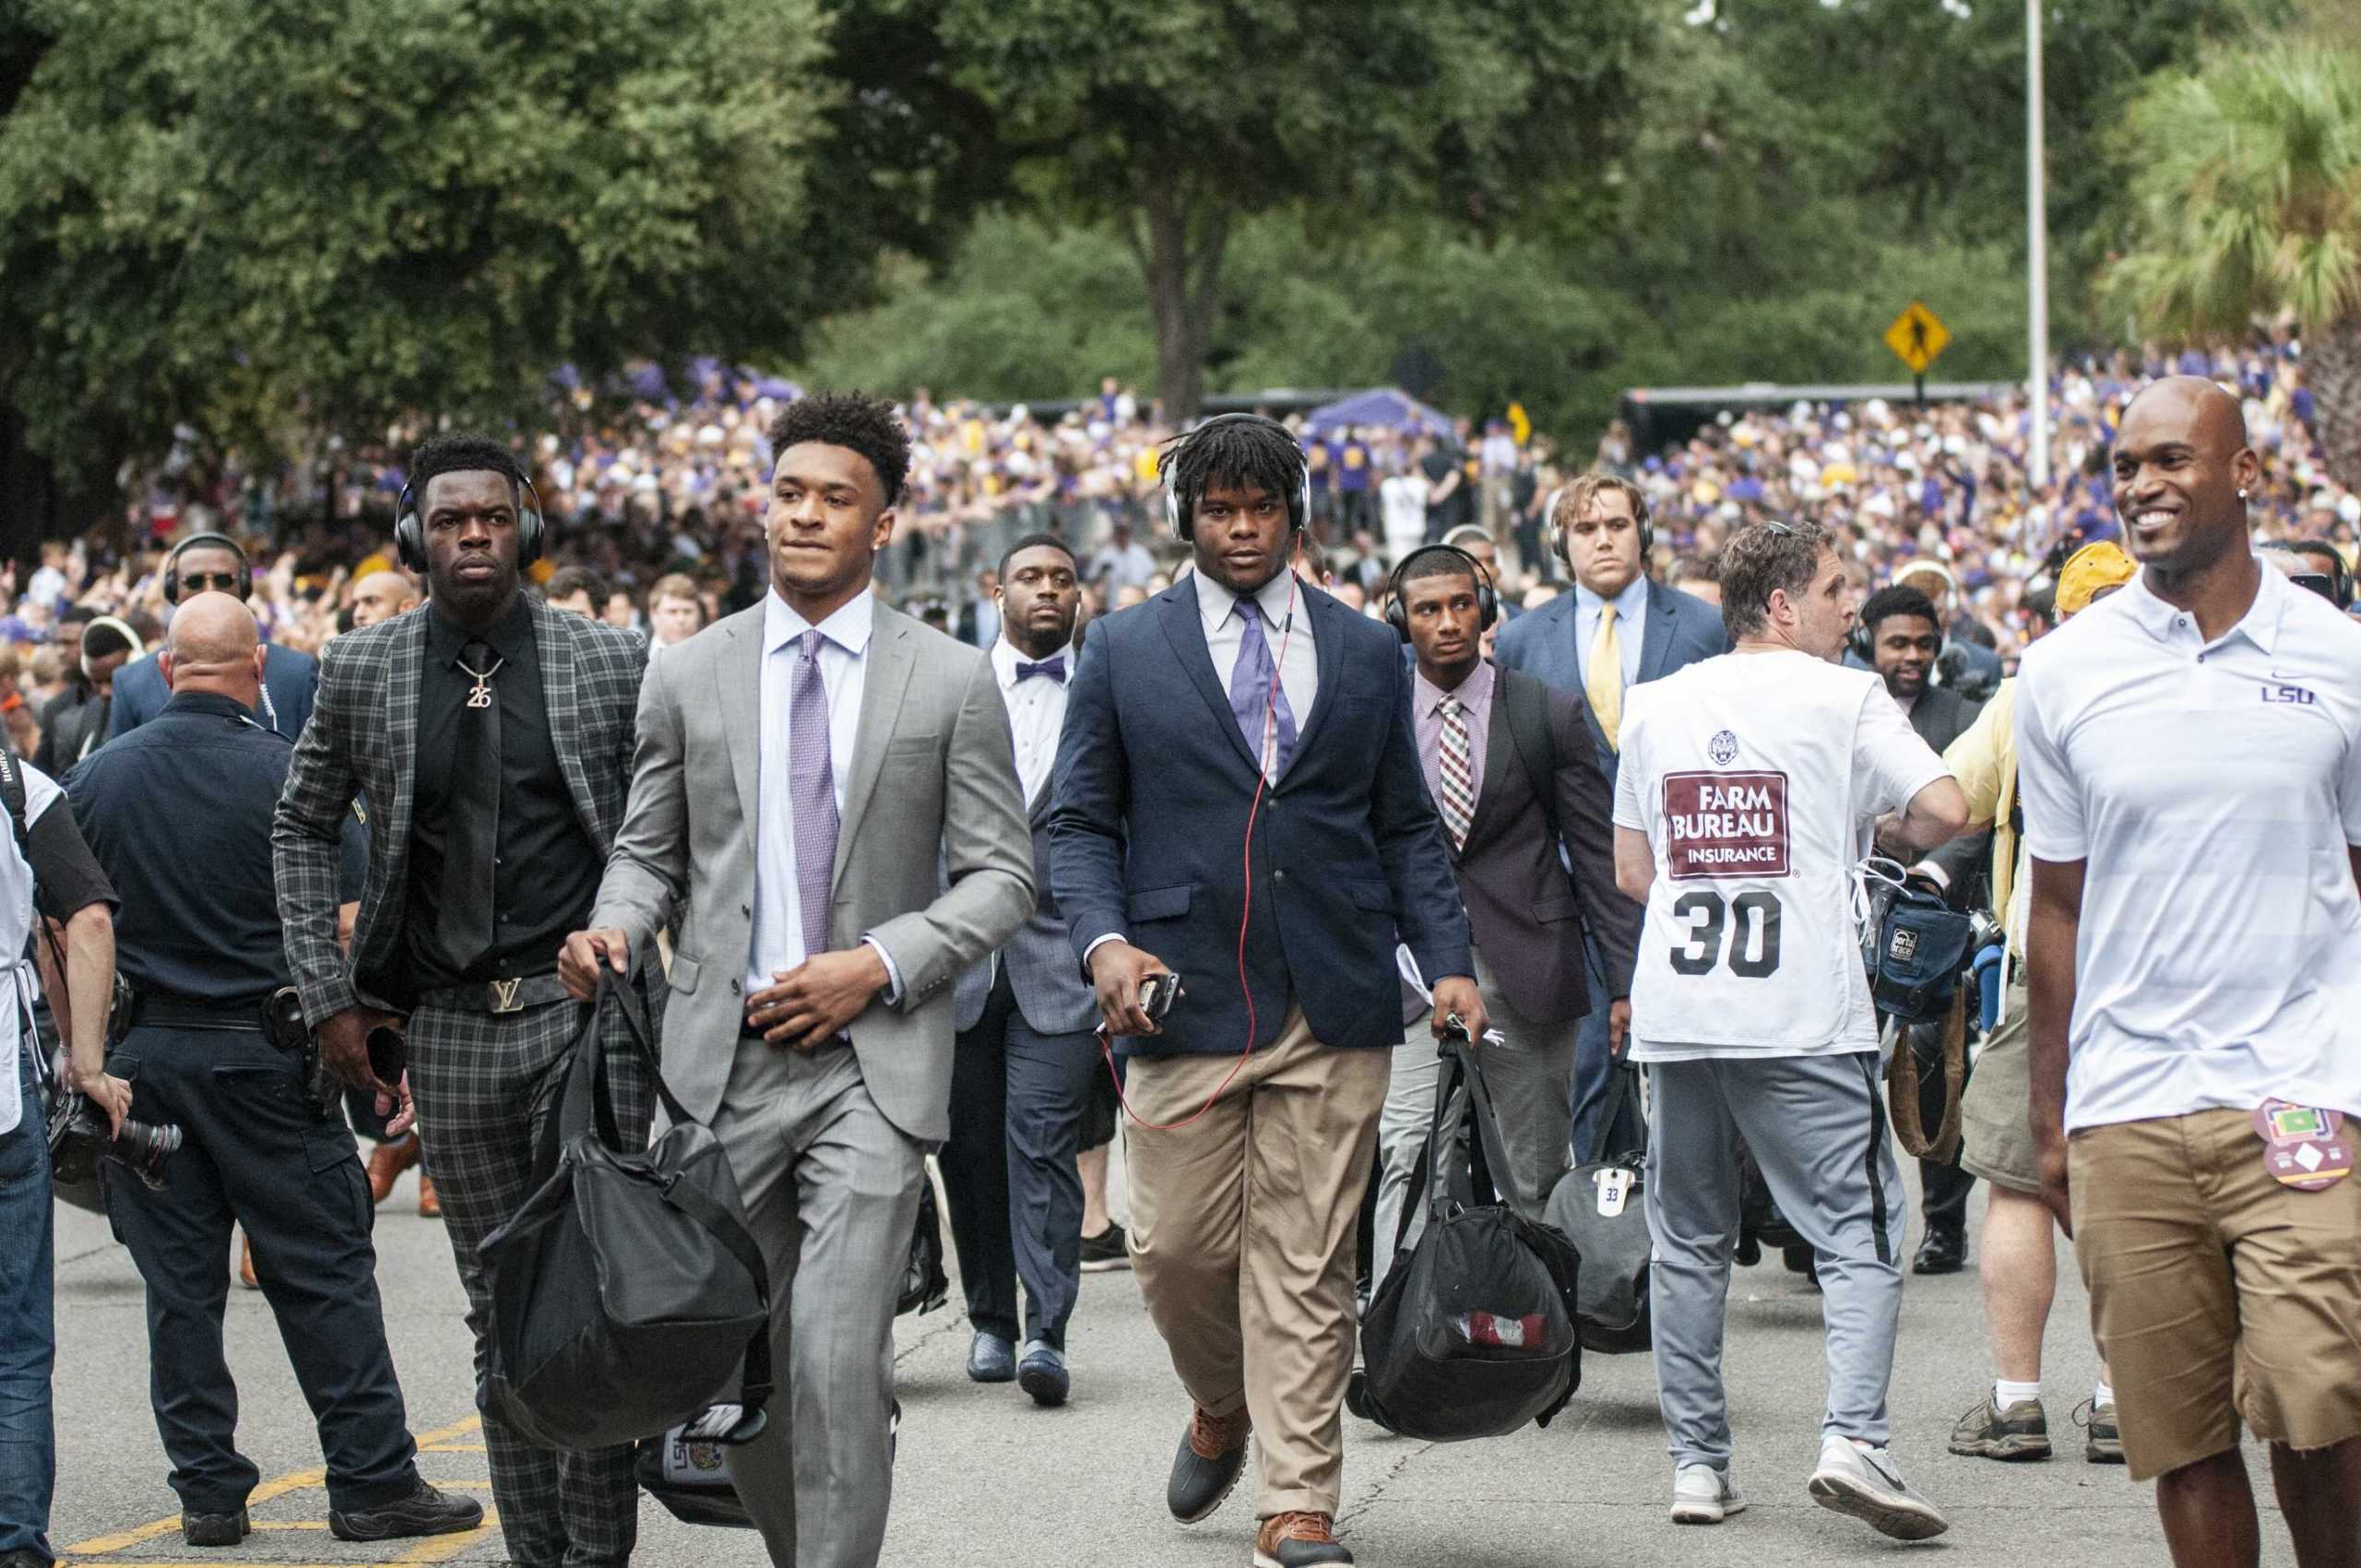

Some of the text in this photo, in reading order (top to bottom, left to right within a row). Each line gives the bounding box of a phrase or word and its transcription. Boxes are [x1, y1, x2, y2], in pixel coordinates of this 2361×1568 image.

[467, 686, 492, 707] 26
[2261, 686, 2314, 705] LSU
[1699, 785, 1772, 811] FARM
[1672, 814, 1774, 840] BUREAU
[1689, 846, 1776, 863] INSURANCE
[1669, 891, 1782, 978] 30
[1606, 1188, 1619, 1202] 33
